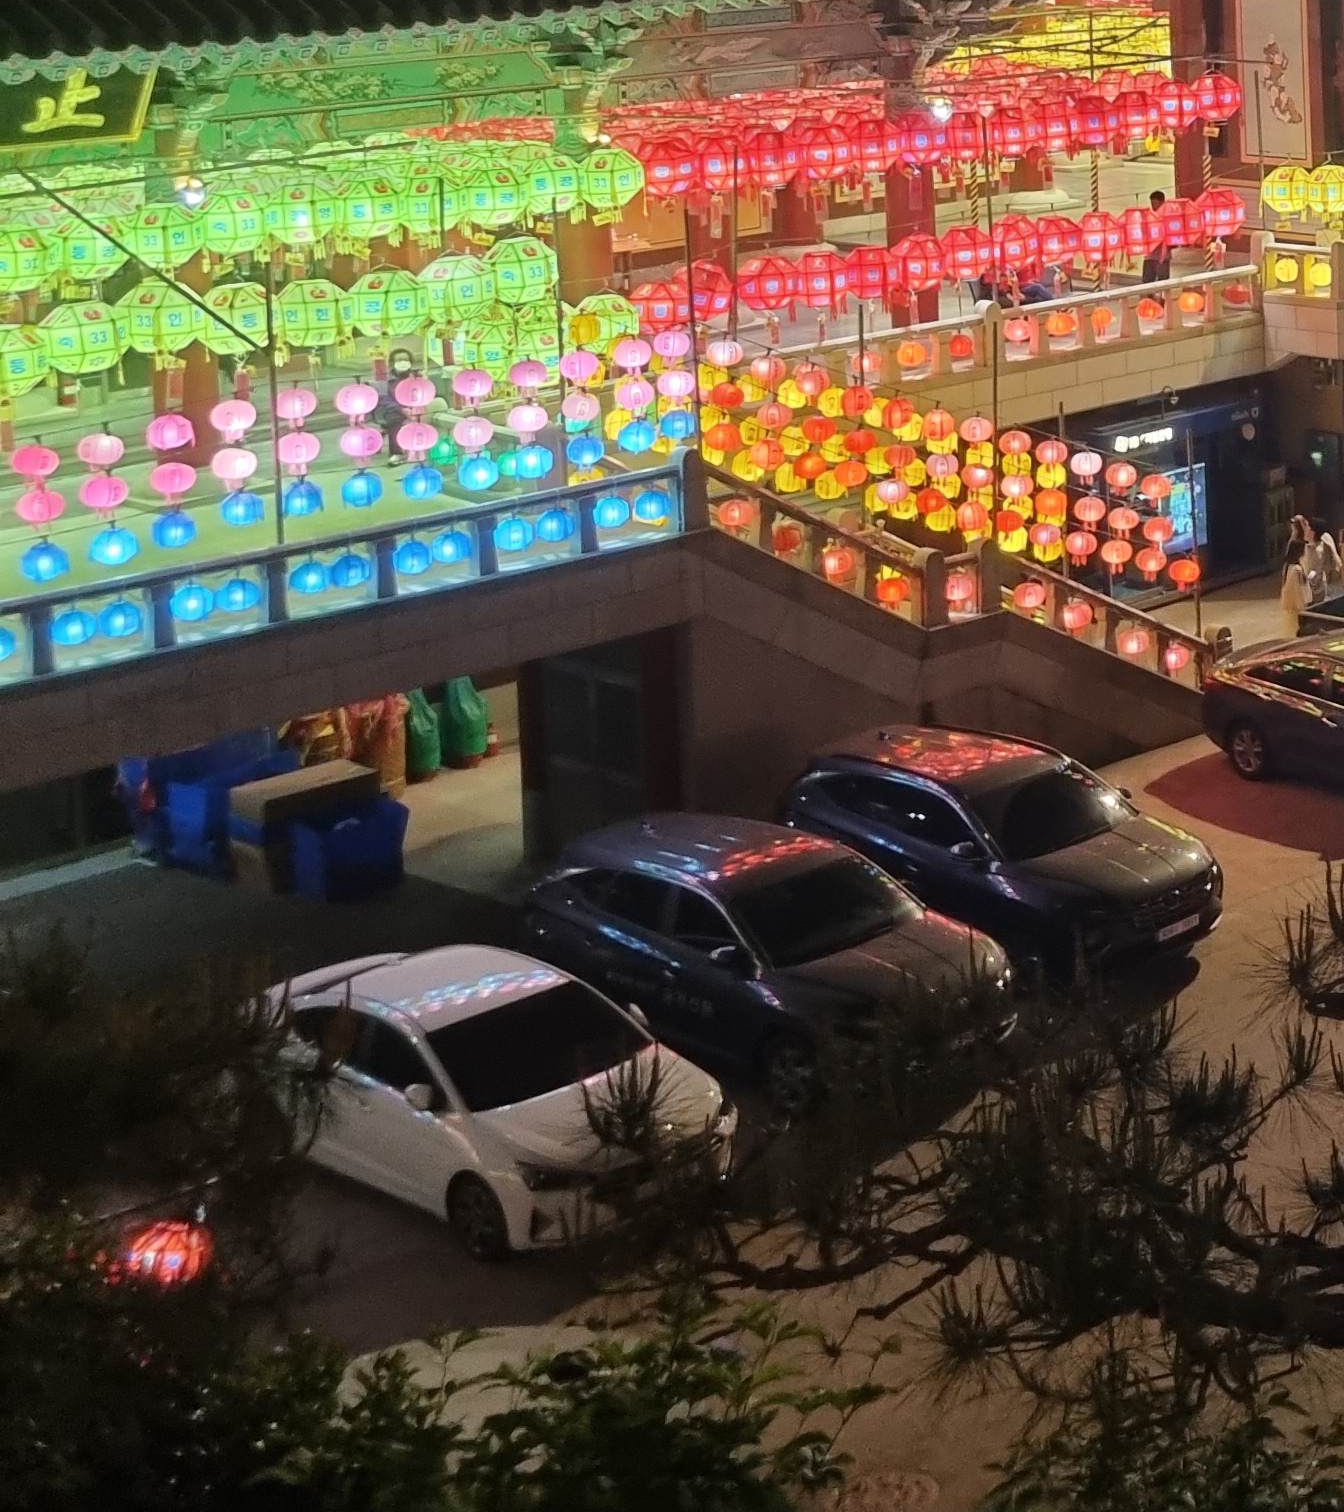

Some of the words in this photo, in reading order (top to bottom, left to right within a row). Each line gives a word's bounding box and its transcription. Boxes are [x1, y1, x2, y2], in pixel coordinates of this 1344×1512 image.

[593, 177, 607, 188] 33
[414, 202, 428, 214] 33
[240, 218, 256, 230] 33
[143, 235, 158, 246] 33
[529, 265, 543, 279] 33
[460, 283, 474, 298] 인
[136, 314, 152, 328] 33
[168, 312, 182, 328] 인
[90, 330, 107, 345] 33
